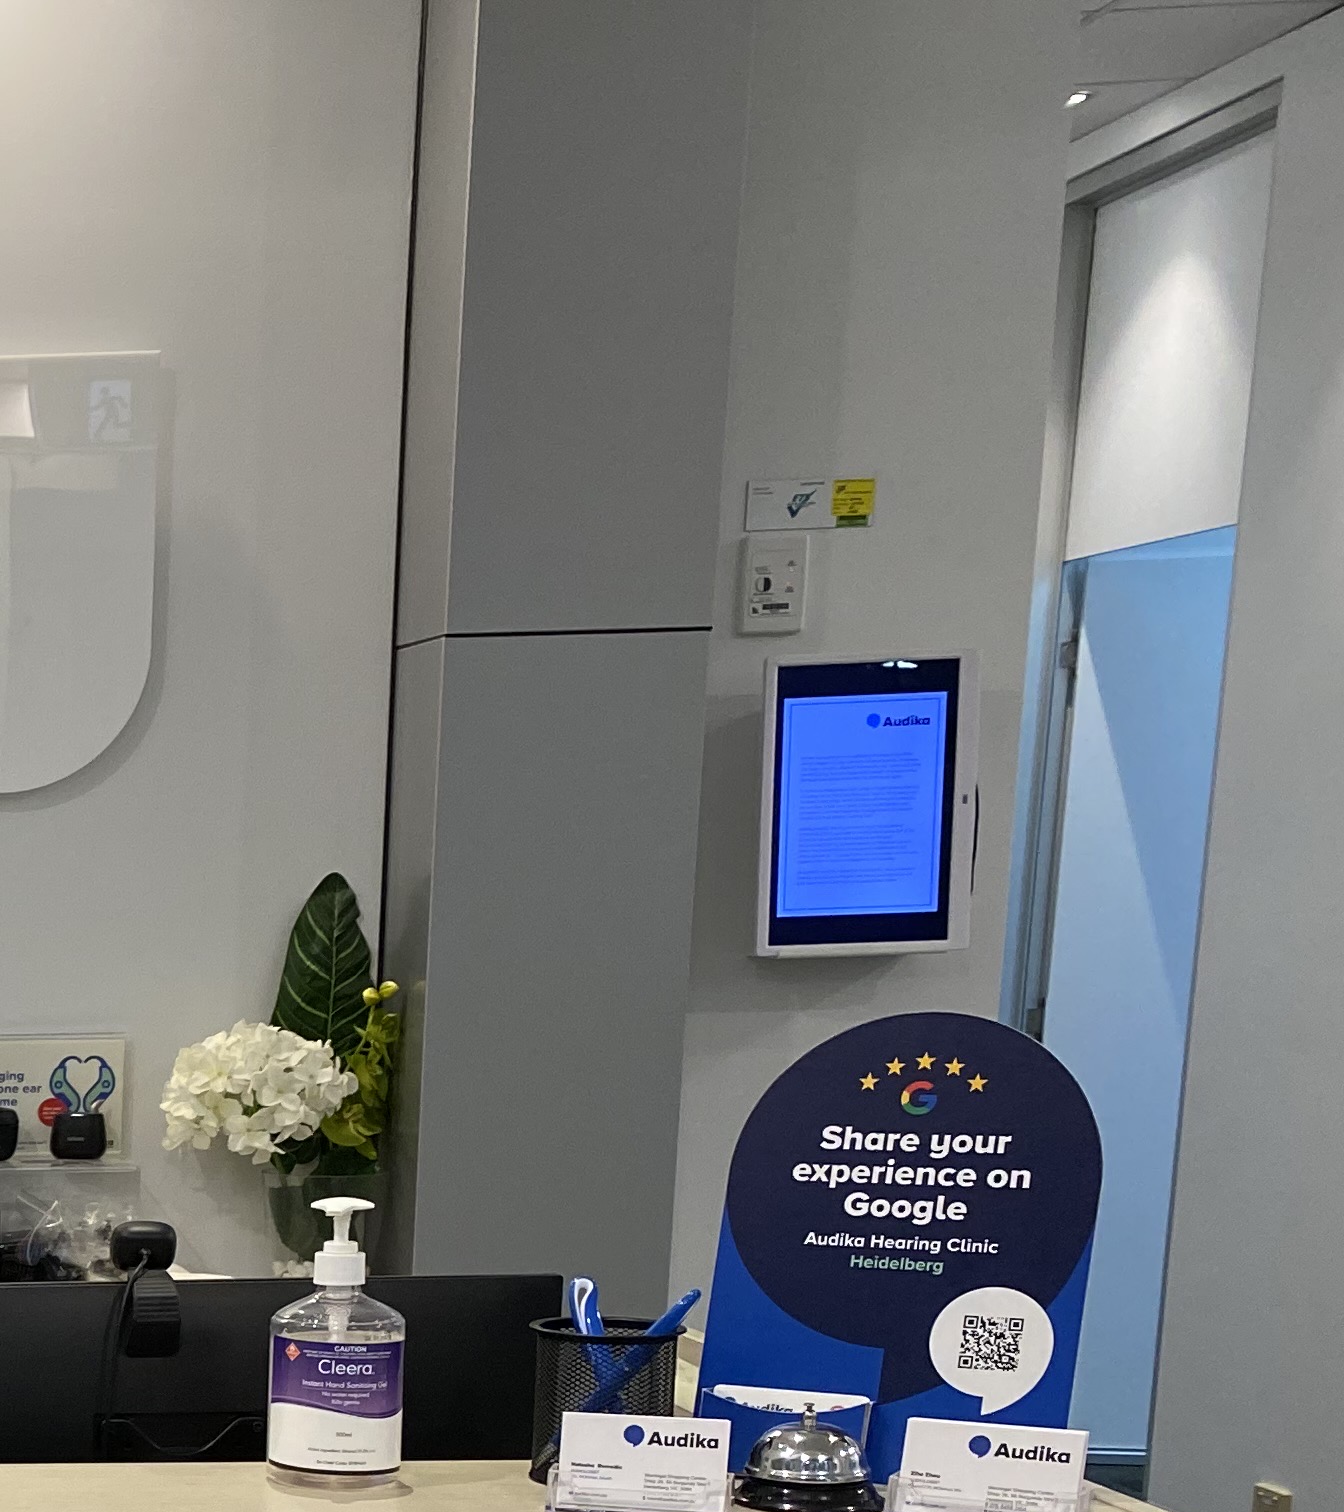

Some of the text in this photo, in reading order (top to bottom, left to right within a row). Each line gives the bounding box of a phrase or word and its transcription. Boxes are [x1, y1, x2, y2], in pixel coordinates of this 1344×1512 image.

[882, 714, 931, 727] Audika
[22, 1085, 43, 1094] ear
[819, 1125, 1013, 1159] Share your
[791, 1158, 1032, 1189] experience on
[843, 1191, 968, 1226] Google
[802, 1231, 999, 1254] Audika Hearing Clinic
[849, 1254, 945, 1276] Heidelberg
[333, 1345, 367, 1353] CAUTION
[318, 1359, 374, 1375] Cleera
[301, 1378, 324, 1388] Instant
[325, 1379, 345, 1388] Hand
[647, 1431, 719, 1449] Audika
[994, 1442, 1071, 1464] Audika
